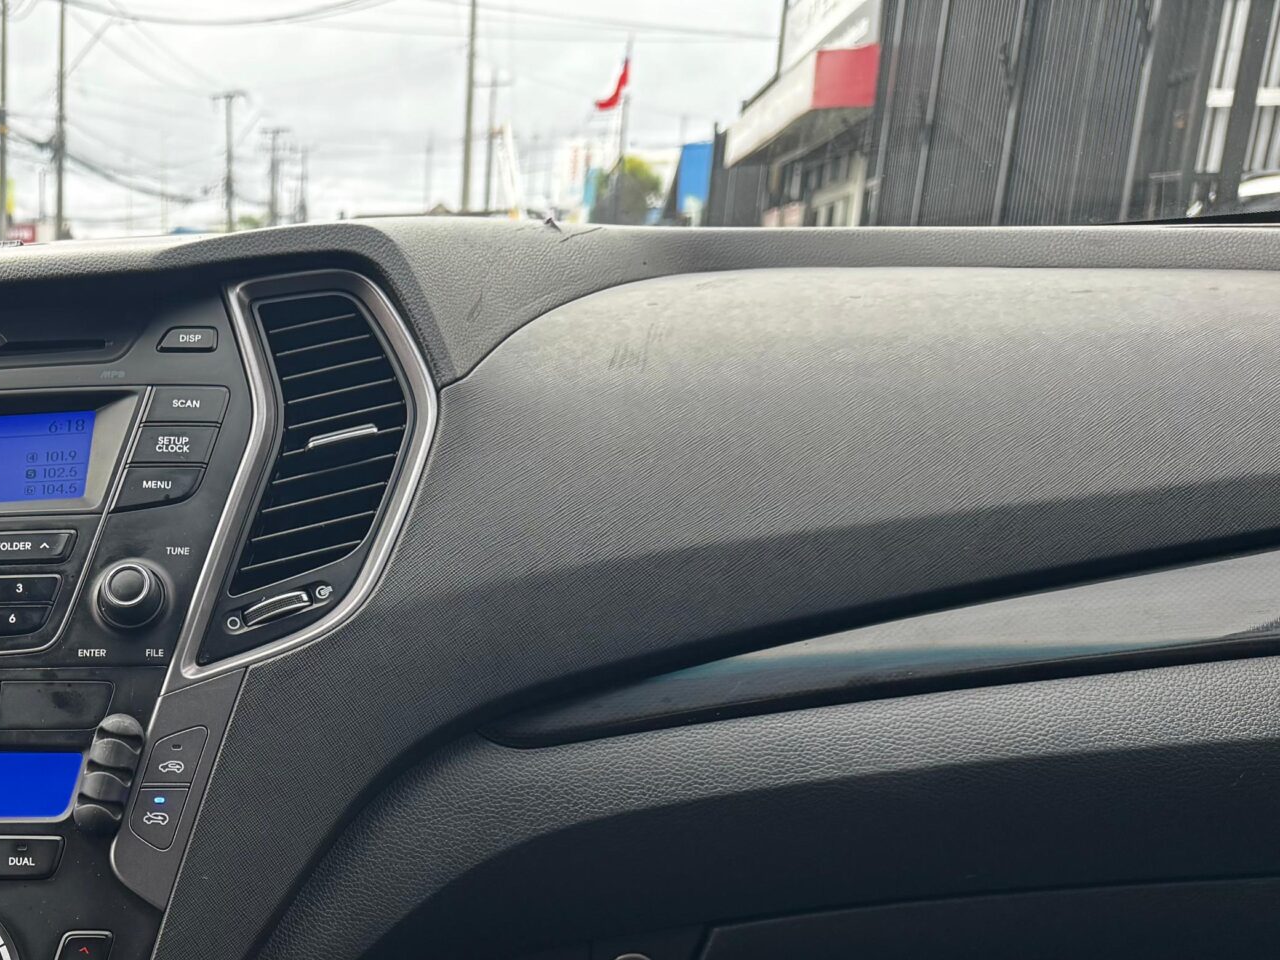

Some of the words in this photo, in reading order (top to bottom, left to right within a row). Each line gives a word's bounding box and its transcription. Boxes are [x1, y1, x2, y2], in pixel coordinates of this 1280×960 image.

[179, 334, 202, 343] DISP
[172, 400, 200, 408] SCAN
[48, 419, 85, 433] 6:18
[158, 437, 189, 445] SETUP
[156, 445, 190, 453] CLOCK
[46, 450, 77, 462] 101.9
[43, 466, 78, 478] 102.5
[42, 483, 77, 495] 104.5
[143, 480, 172, 489] MENU
[166, 547, 190, 555] TUNE
[16, 583, 23, 593] 3
[8, 614, 16, 624] 6
[78, 649, 107, 657] ENTER
[145, 649, 164, 657] FILE
[8, 856, 35, 866] DUAL
